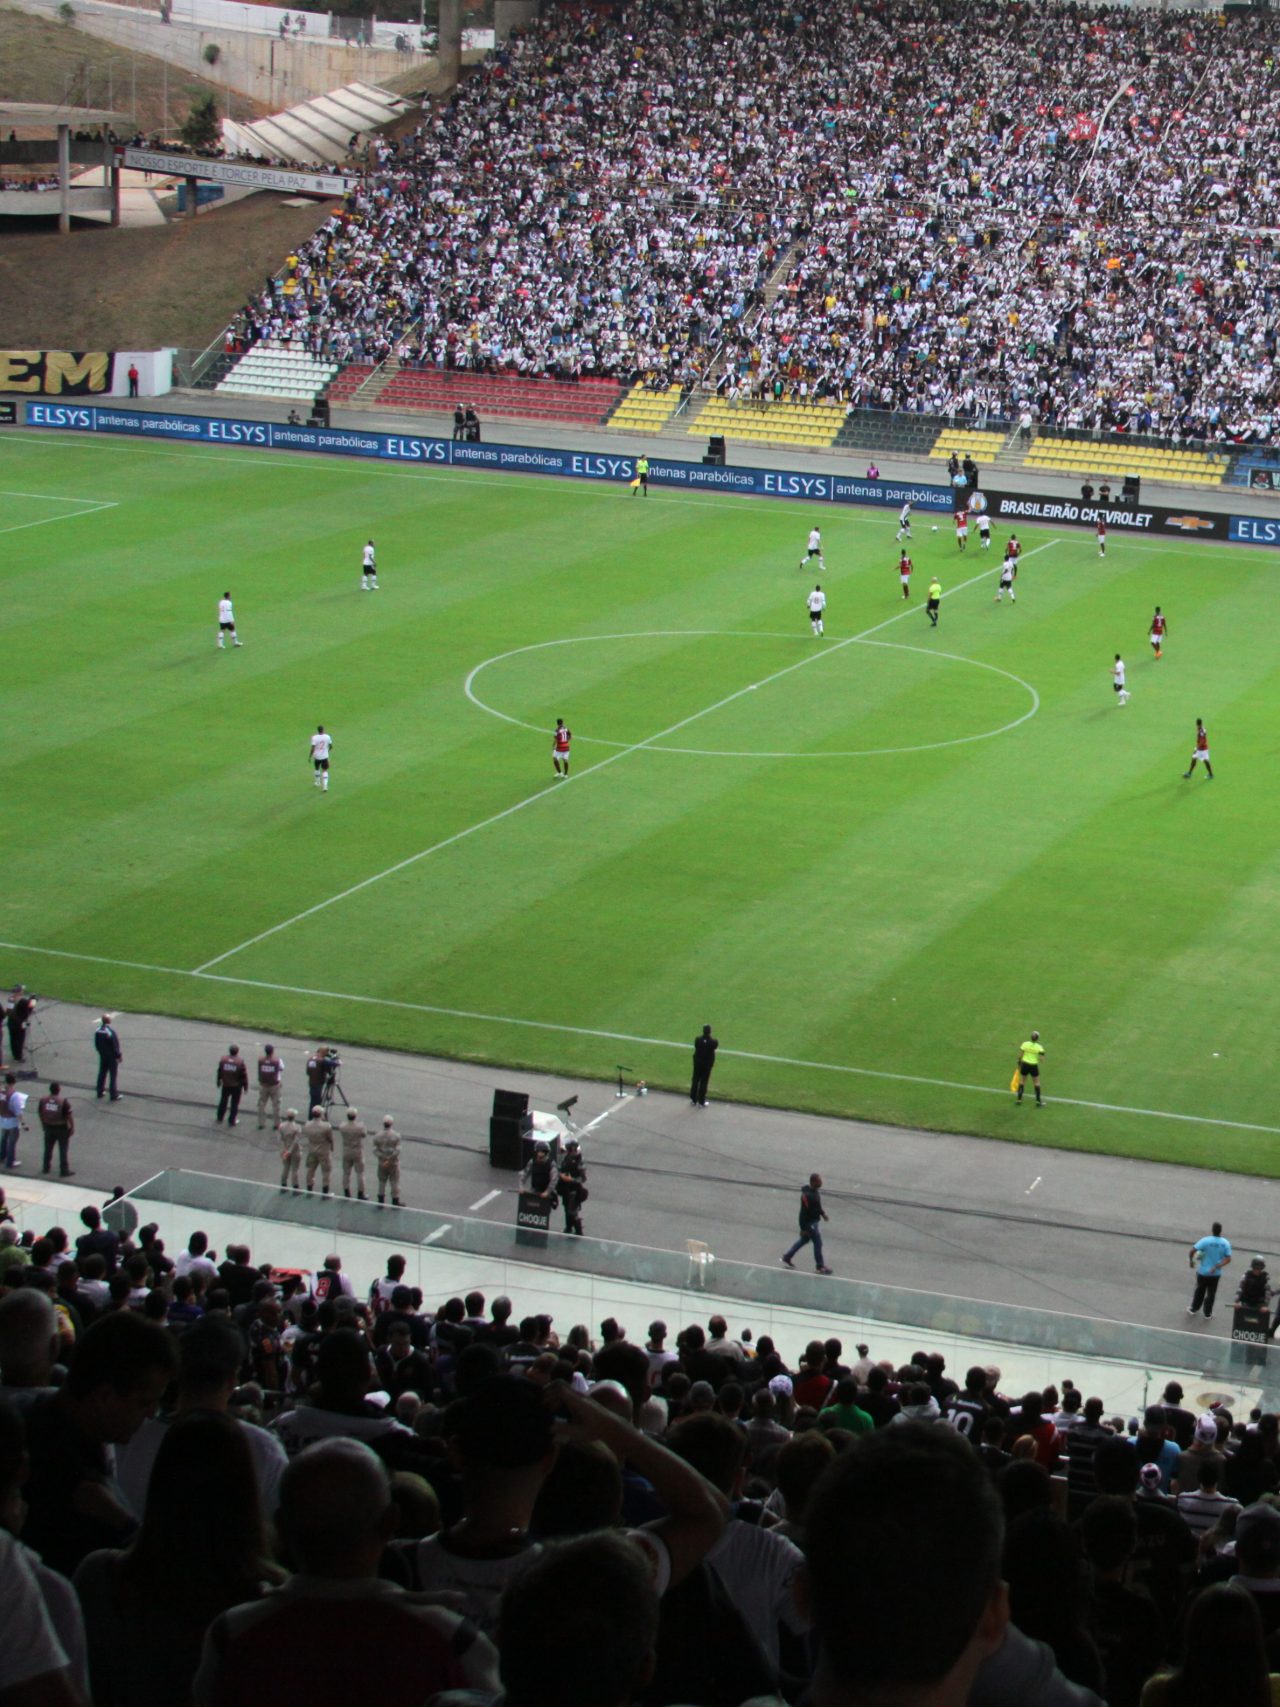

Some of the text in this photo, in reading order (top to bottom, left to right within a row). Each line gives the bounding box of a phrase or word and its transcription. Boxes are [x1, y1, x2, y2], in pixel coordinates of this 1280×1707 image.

[130, 155, 165, 169] NOSSO
[168, 159, 209, 176] ESPORTE
[221, 168, 259, 182] TORCER
[262, 173, 286, 186] PELA
[288, 177, 307, 188] PAZ
[32, 406, 90, 426] ELSYS
[99, 416, 200, 433] antenas parabólicas
[208, 422, 266, 443] ELSYS
[274, 431, 379, 450] antenas parabólicas
[387, 439, 446, 459] ELSYS
[454, 449, 563, 468] antenas parabólicas
[572, 456, 632, 478] ELSYS
[647, 466, 754, 485] ntenas parabólicas
[764, 474, 827, 496] ELSYS
[836, 484, 953, 505] antenas parabólicas
[1000, 500, 1079, 520] BRASILEIRÃO
[519, 1212, 547, 1226] CHOQUE
[316, 1277, 330, 1297] 8
[1232, 1329, 1266, 1343] CHOQUE
